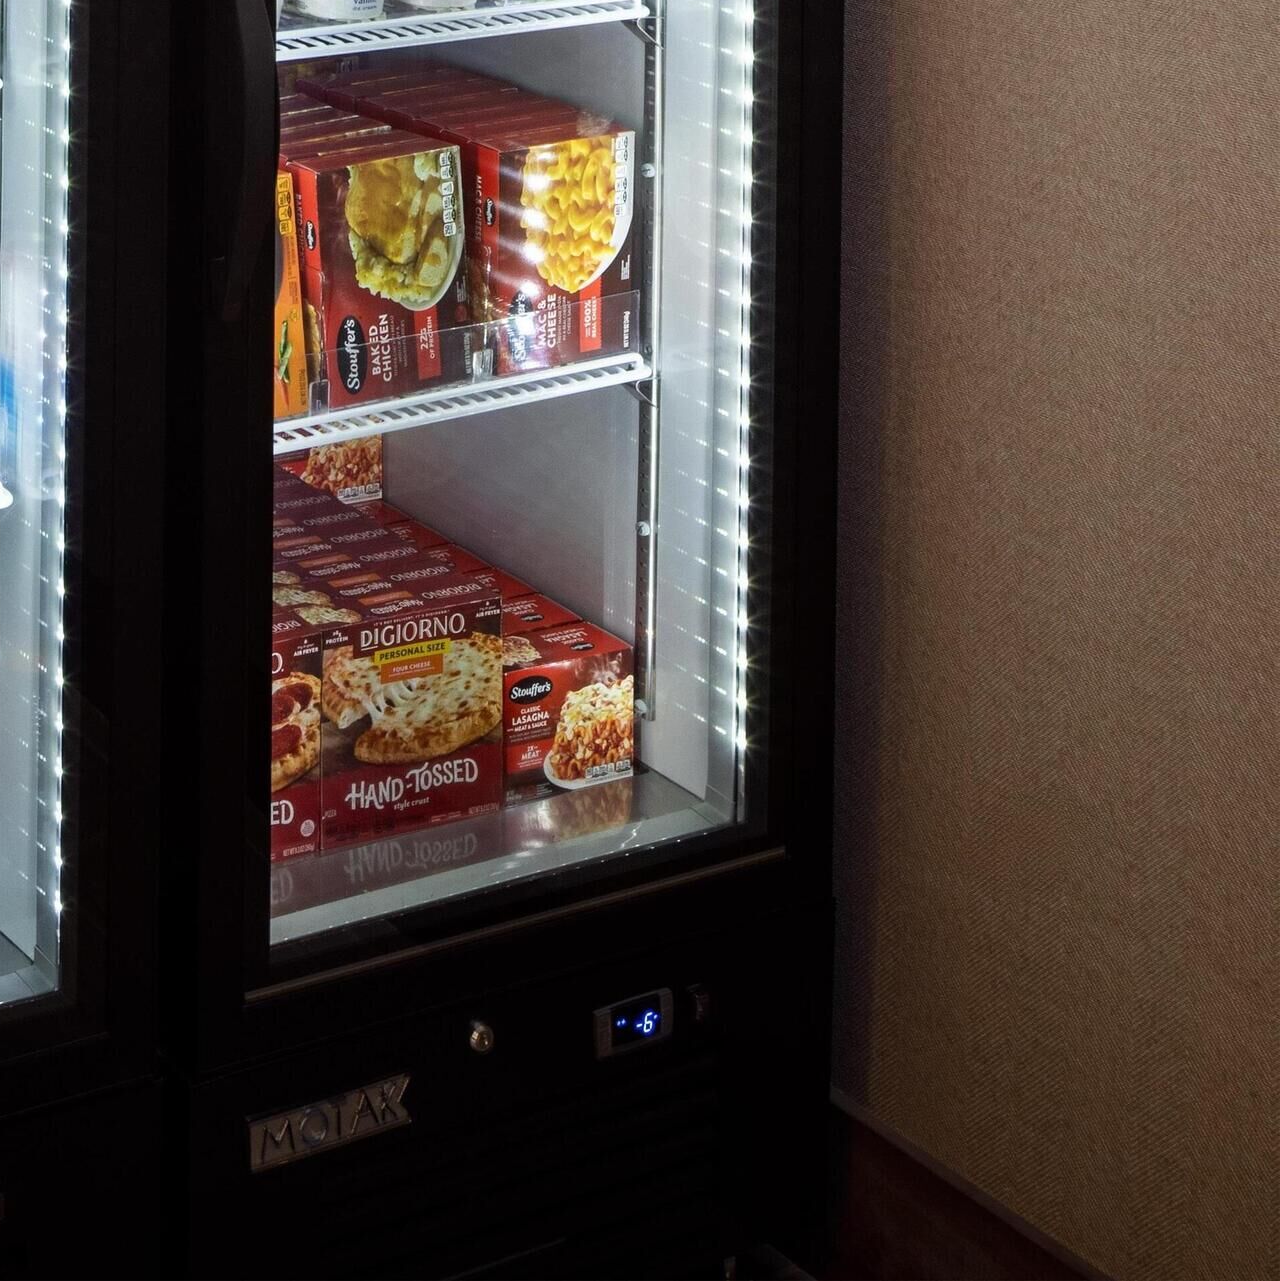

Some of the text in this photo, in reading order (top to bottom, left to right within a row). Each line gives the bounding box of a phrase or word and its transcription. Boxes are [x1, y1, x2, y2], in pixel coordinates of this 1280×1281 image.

[547, 293, 557, 348] CHEESE
[344, 319, 361, 389] Stouffer's
[369, 325, 381, 375] BAKED
[378, 313, 392, 382] CHICKEN
[360, 613, 464, 650] DIGIORNO
[303, 647, 319, 655] FRYER
[379, 642, 446, 661] PERSONAL SIZE
[392, 661, 431, 673] FOUR CHEESE
[510, 681, 551, 700] Stouffer's
[512, 712, 550, 726] LASAGNA
[520, 705, 541, 715] CLASSIC
[514, 720, 547, 732] MEAT SAUCE
[521, 750, 540, 761] MEAT
[344, 758, 478, 810] HAND-TOSSED
[393, 797, 430, 812] style crust
